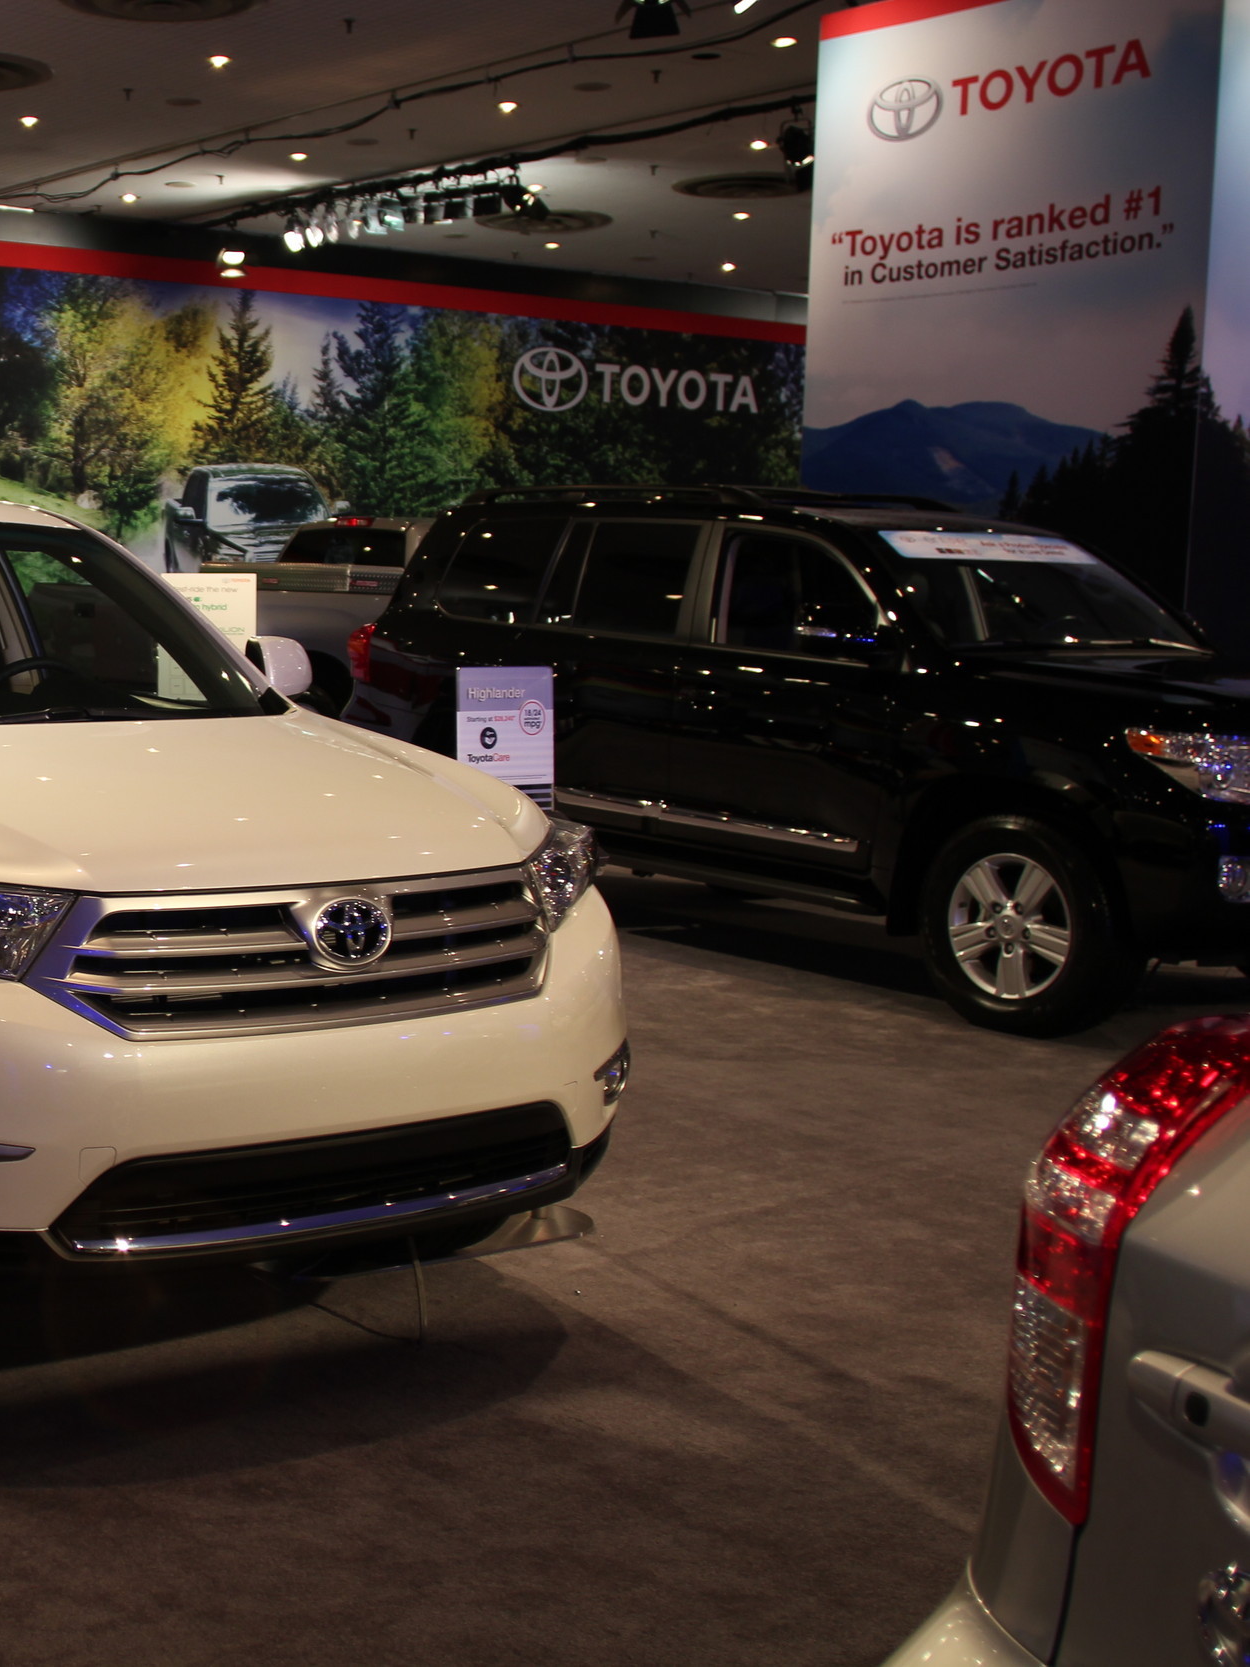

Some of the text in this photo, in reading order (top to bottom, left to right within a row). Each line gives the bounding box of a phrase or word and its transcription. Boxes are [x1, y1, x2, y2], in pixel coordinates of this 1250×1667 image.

[952, 38, 1151, 116] TOYOTA
[831, 185, 1162, 260] “Toyota is ranked #1
[843, 223, 1175, 286] in Customer Satisfaction.”
[595, 362, 758, 414] TOYOTA
[467, 687, 526, 702] Highlander
[467, 752, 510, 765] ToyotaCare
